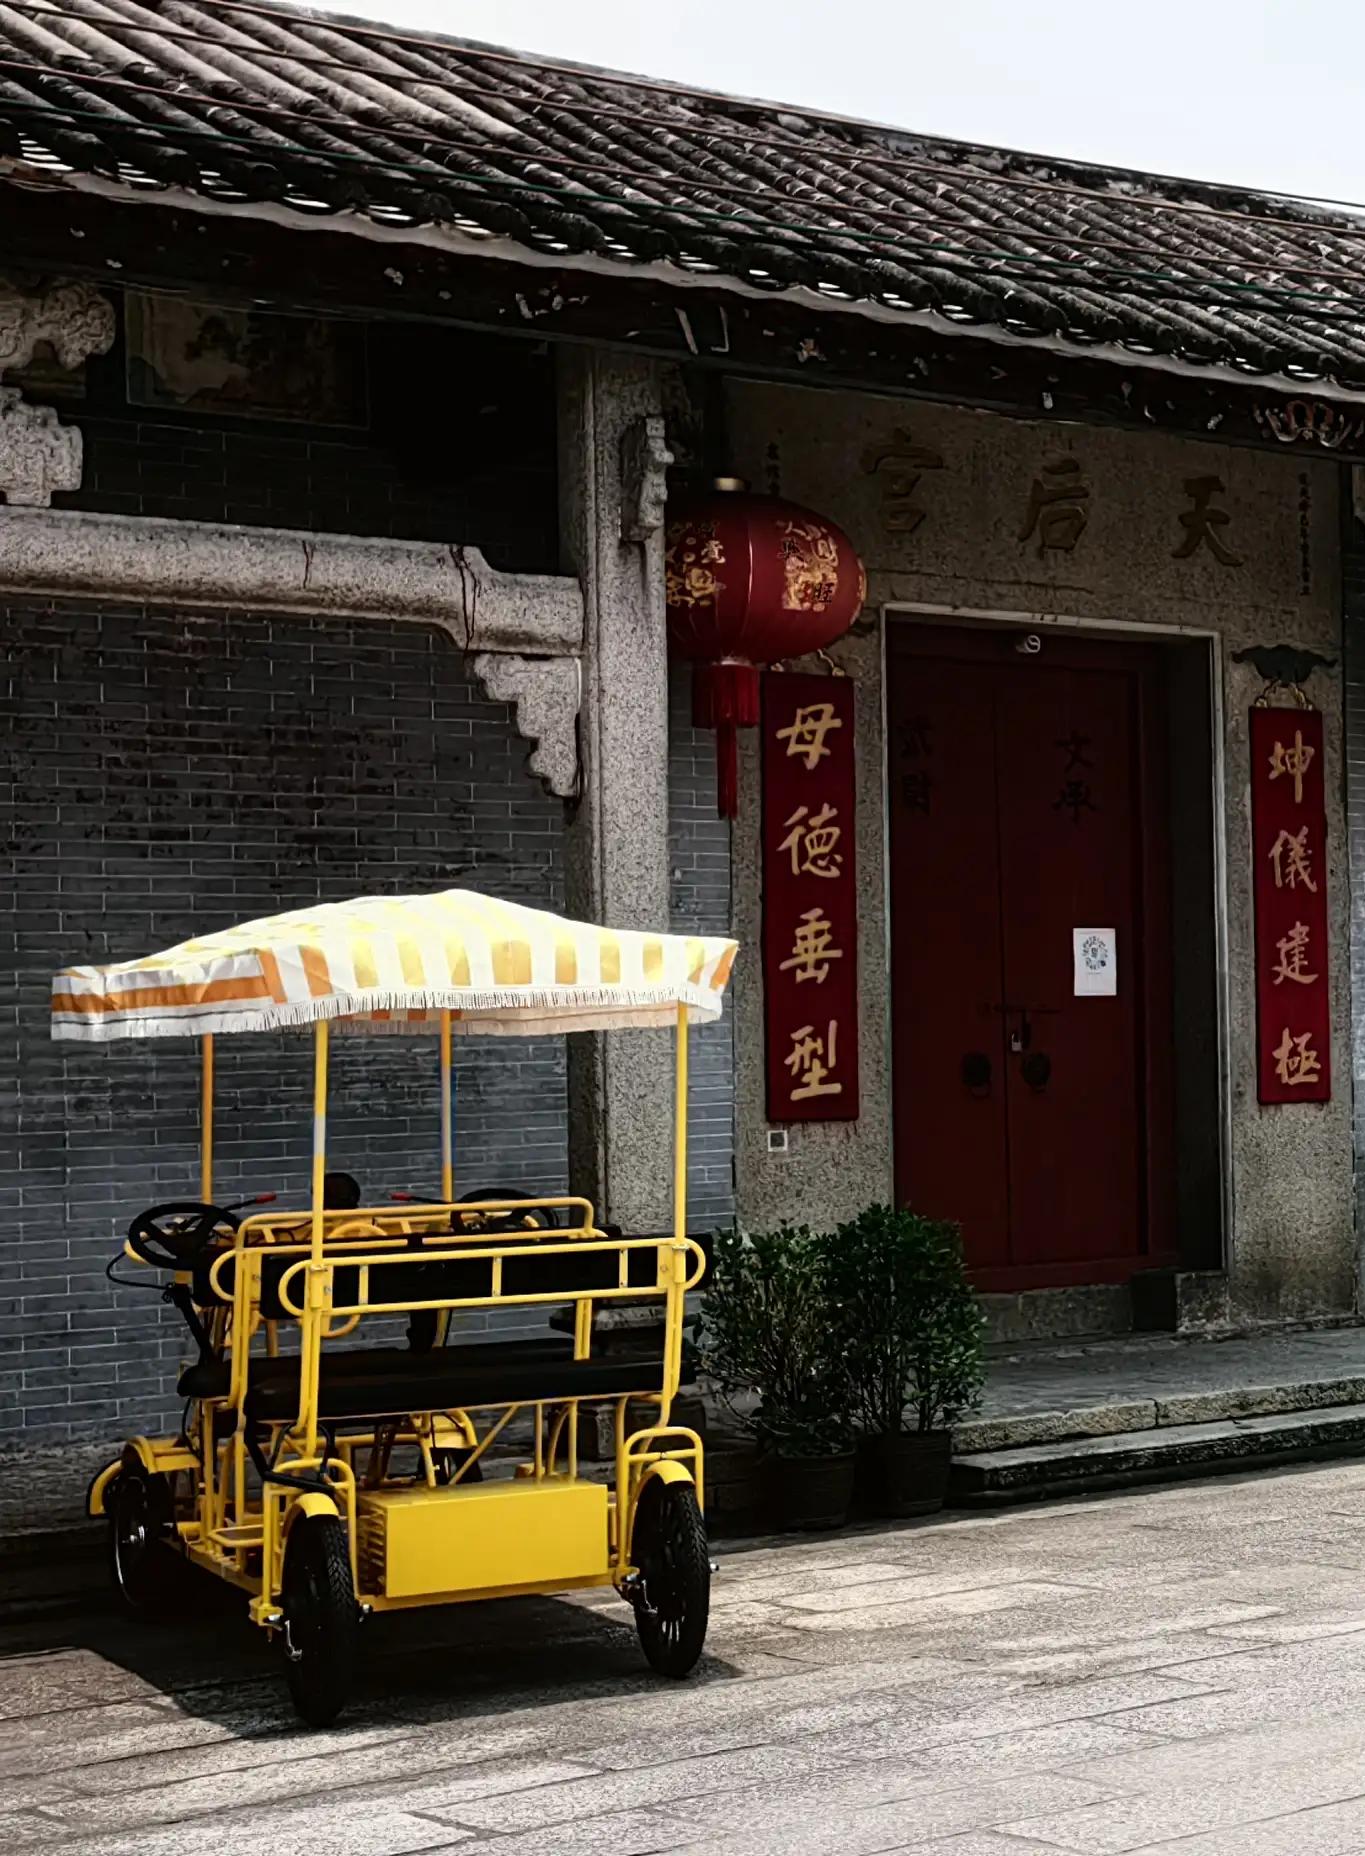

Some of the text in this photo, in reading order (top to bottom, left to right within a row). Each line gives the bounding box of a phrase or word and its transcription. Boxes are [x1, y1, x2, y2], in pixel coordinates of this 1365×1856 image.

[776, 703, 842, 1101] 母德垂型
[1268, 730, 1321, 1083] 坤儀建極
